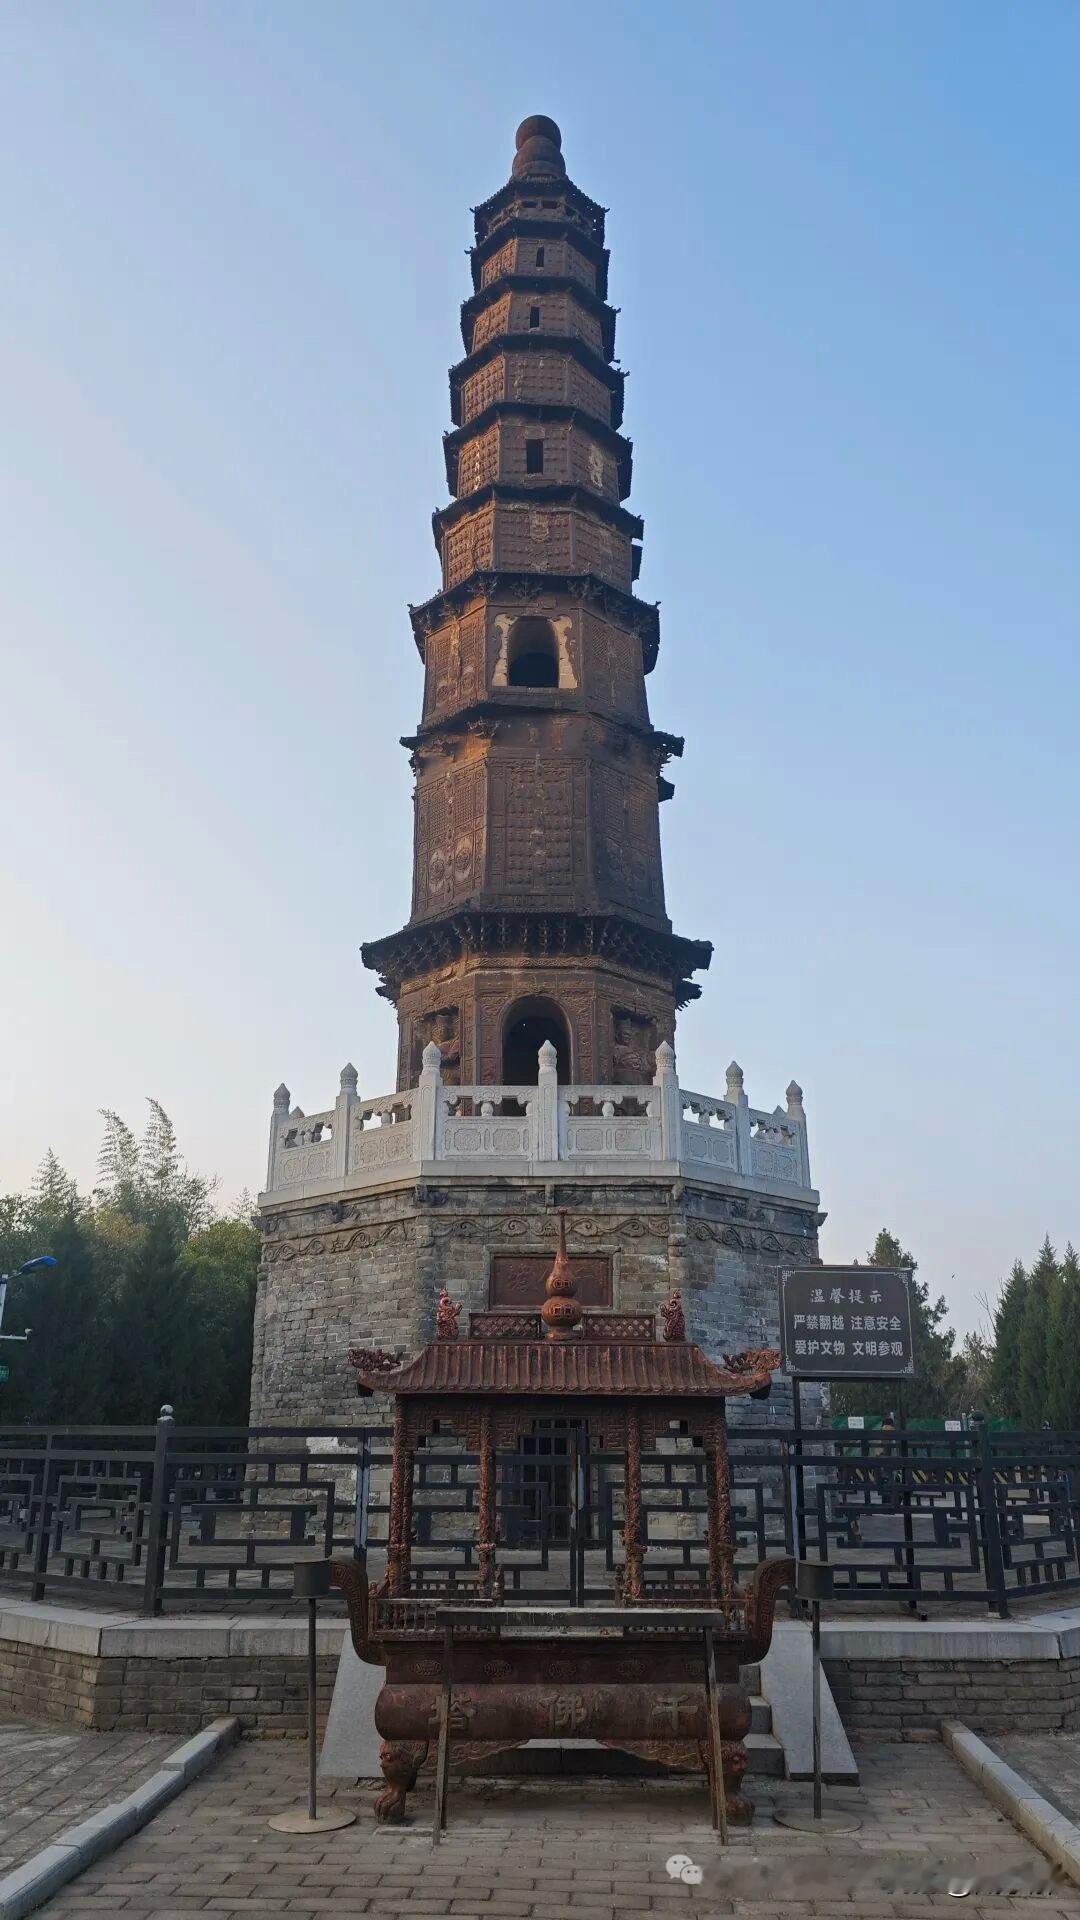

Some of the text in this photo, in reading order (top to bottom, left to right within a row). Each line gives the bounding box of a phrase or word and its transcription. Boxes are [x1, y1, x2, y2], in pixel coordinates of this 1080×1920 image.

[811, 1288, 882, 1304] 温馨提示
[793, 1314, 901, 1331] 严禁翻越 注意安全
[795, 1340, 903, 1356] 爱护文物 文明参观
